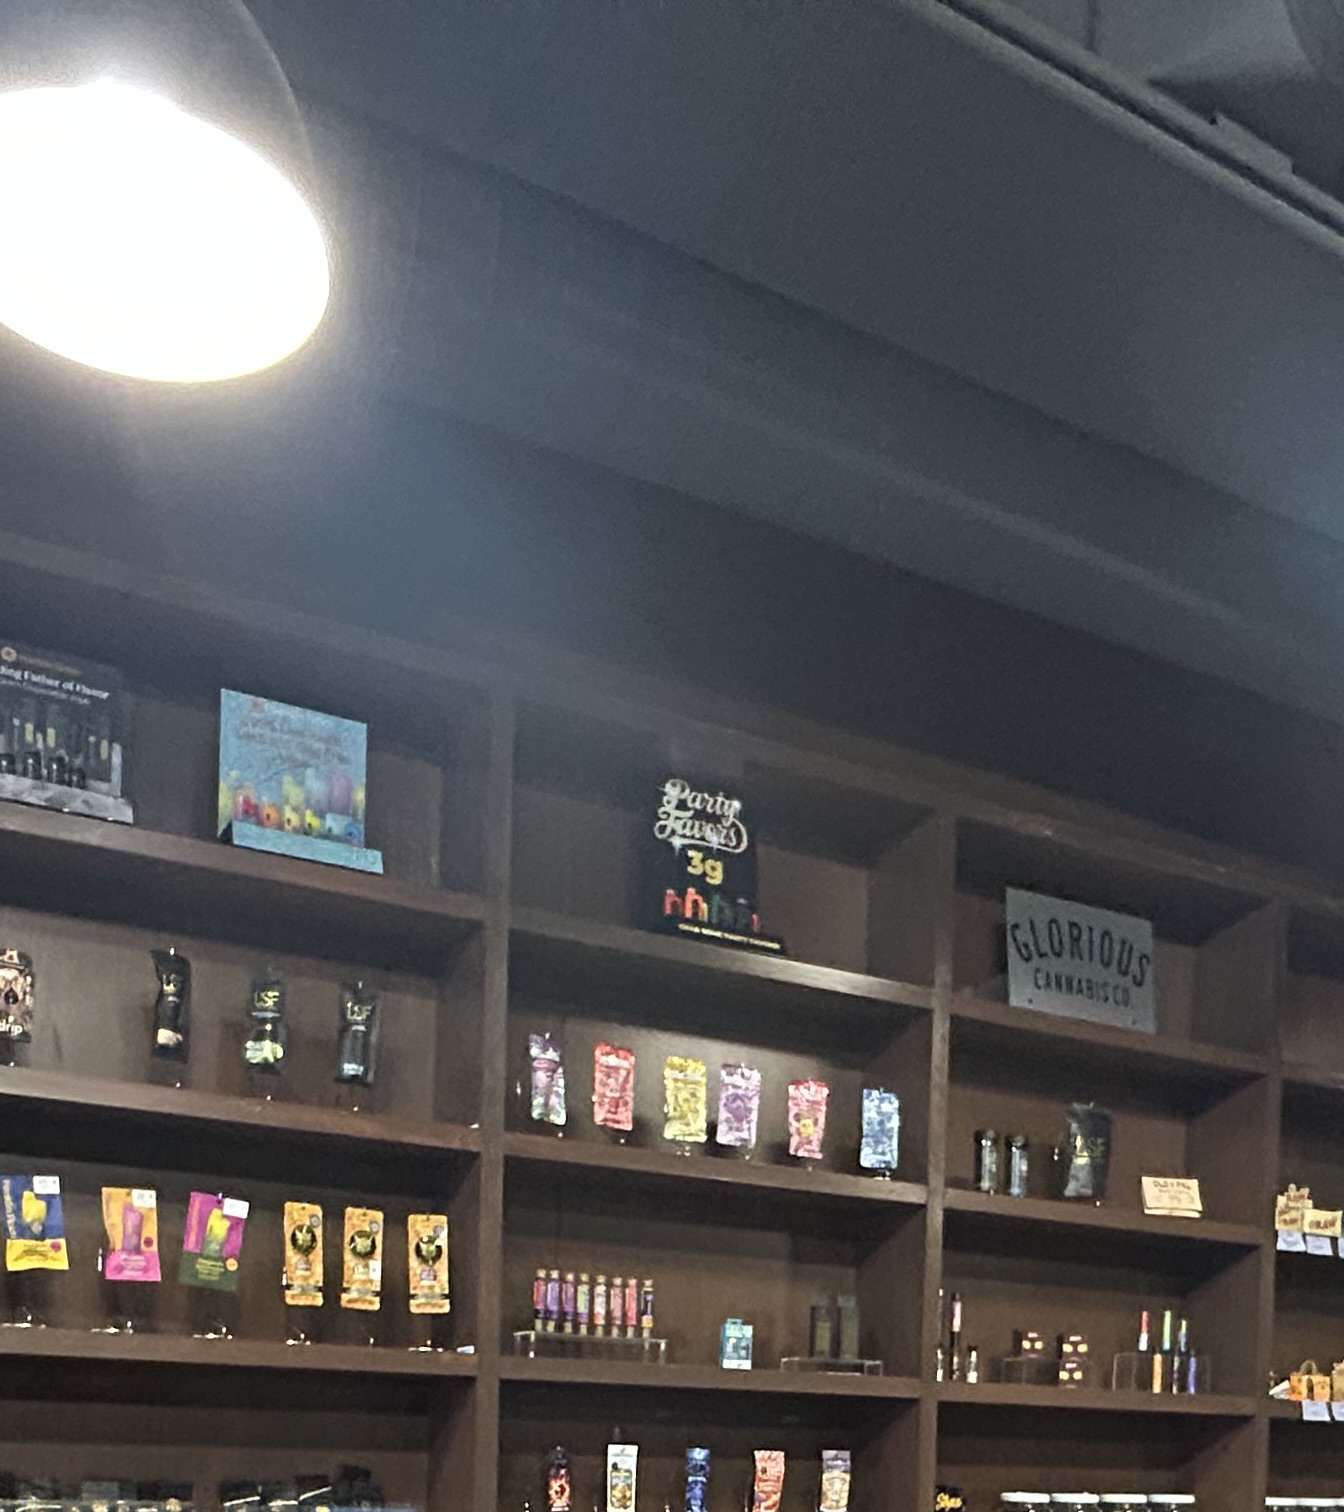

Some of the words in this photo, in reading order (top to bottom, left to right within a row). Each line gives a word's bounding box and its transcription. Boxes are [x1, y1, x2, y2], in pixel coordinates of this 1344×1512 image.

[660, 779, 742, 827] Party
[654, 807, 749, 854] Favors
[687, 850, 724, 885] 3g
[1010, 917, 1151, 988] GLORIOUS
[1034, 967, 1110, 1002] CANNABIS
